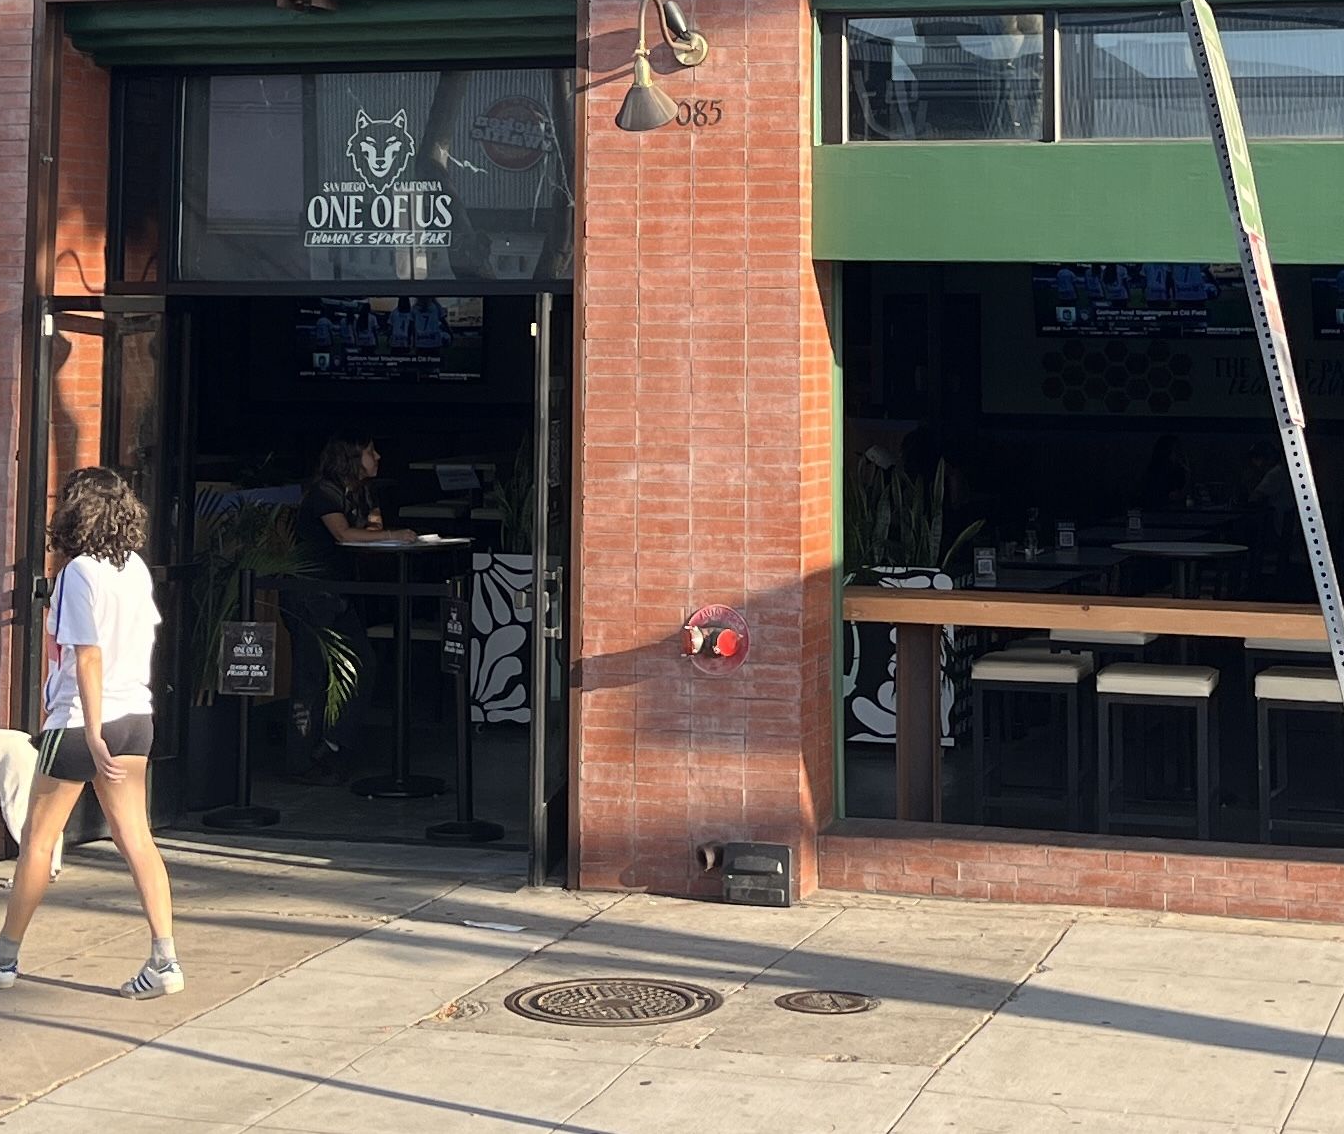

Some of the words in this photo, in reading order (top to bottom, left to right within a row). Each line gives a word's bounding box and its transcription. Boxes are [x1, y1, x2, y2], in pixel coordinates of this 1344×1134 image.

[323, 182, 340, 193] SAN
[341, 182, 366, 192] DIEGO
[394, 181, 443, 192] CALIFORNIA
[307, 195, 363, 228] ONE
[371, 195, 408, 228] OF
[416, 194, 453, 228] US
[311, 232, 363, 244] WOMEN'S
[368, 232, 415, 245] SPORTS
[420, 232, 447, 244] BAR
